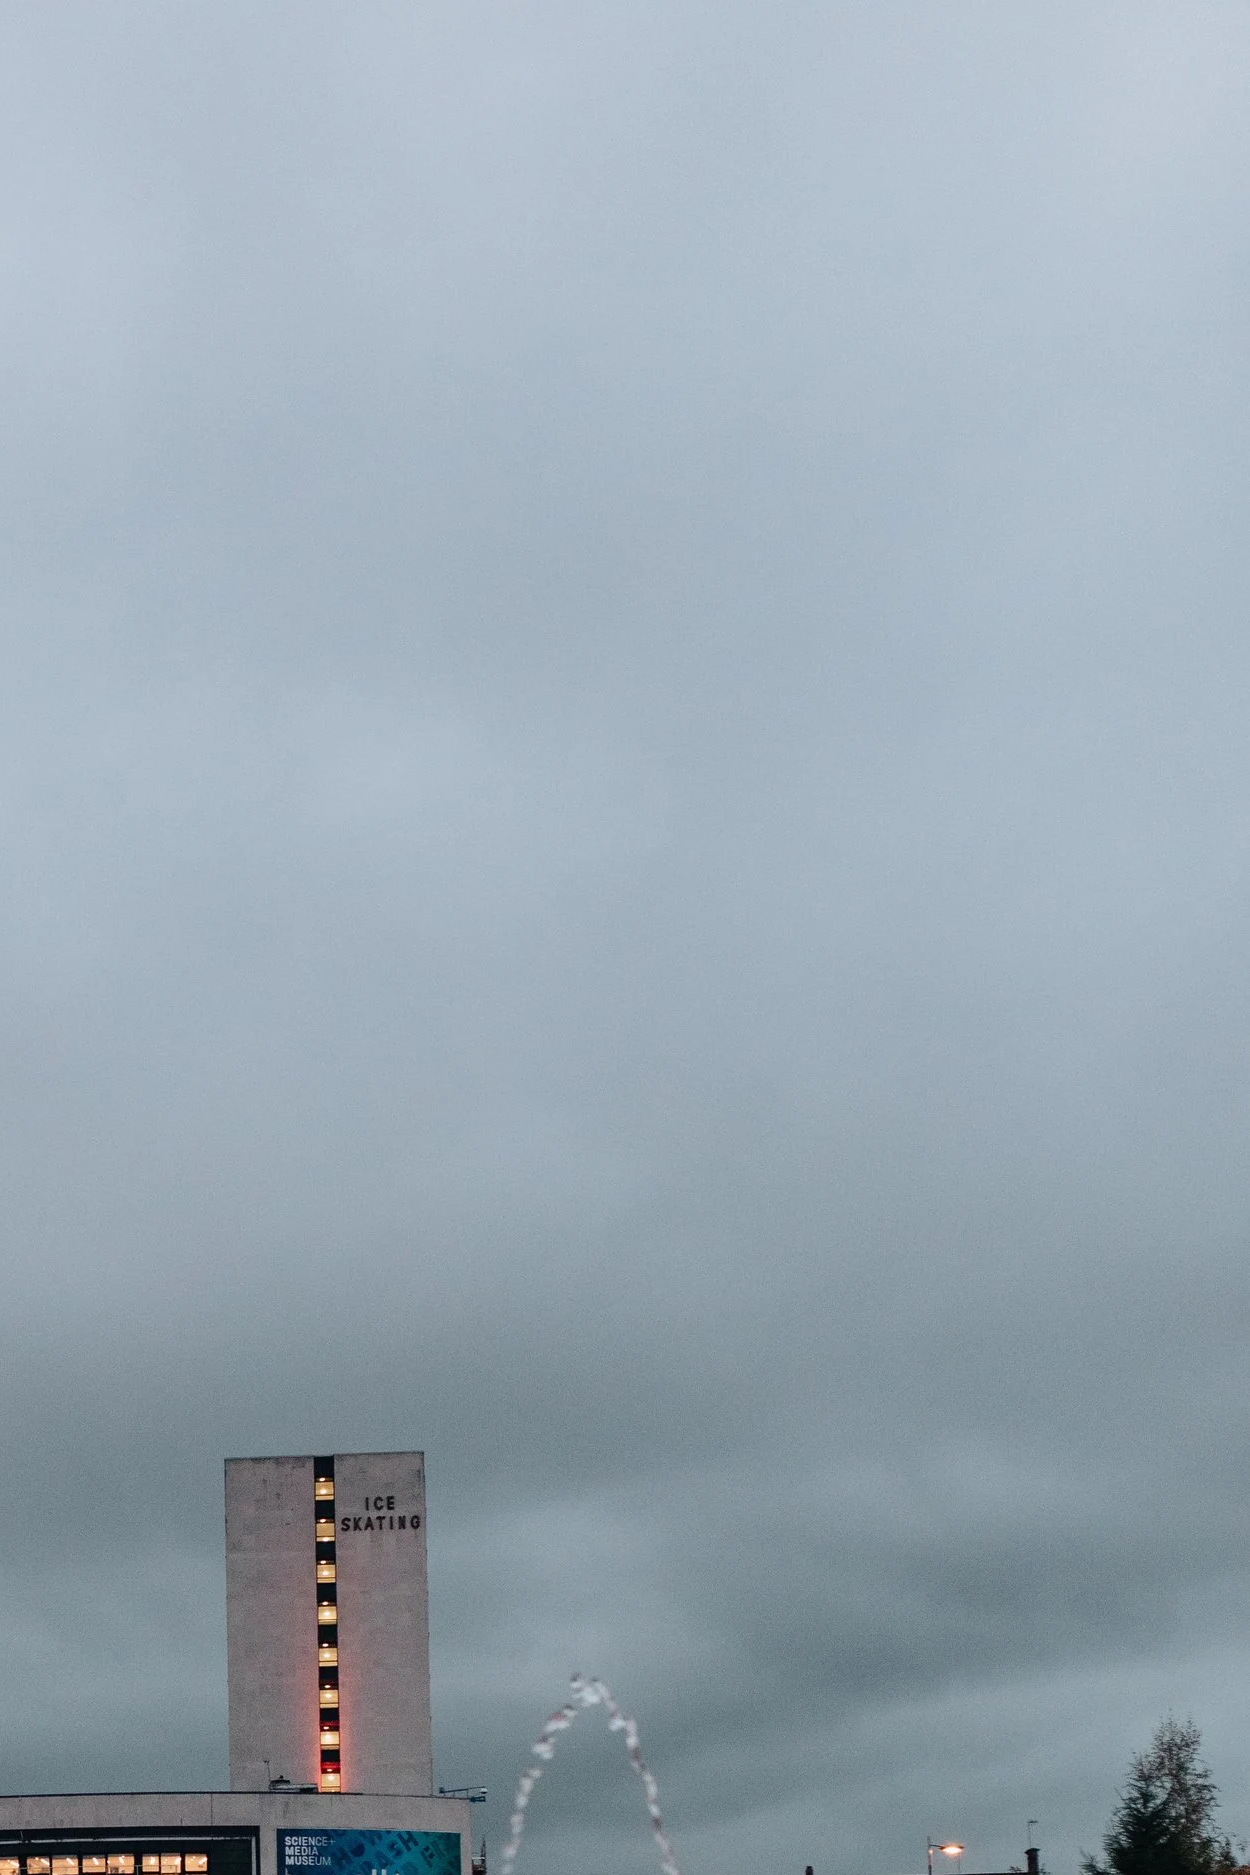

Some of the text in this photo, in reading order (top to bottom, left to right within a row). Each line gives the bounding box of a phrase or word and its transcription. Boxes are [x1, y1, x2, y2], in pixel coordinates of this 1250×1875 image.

[365, 1495, 395, 1511] ICE
[341, 1515, 421, 1532] SKATING
[285, 1847, 318, 1856] MEDIA
[285, 1856, 332, 1866] MUSEUM
